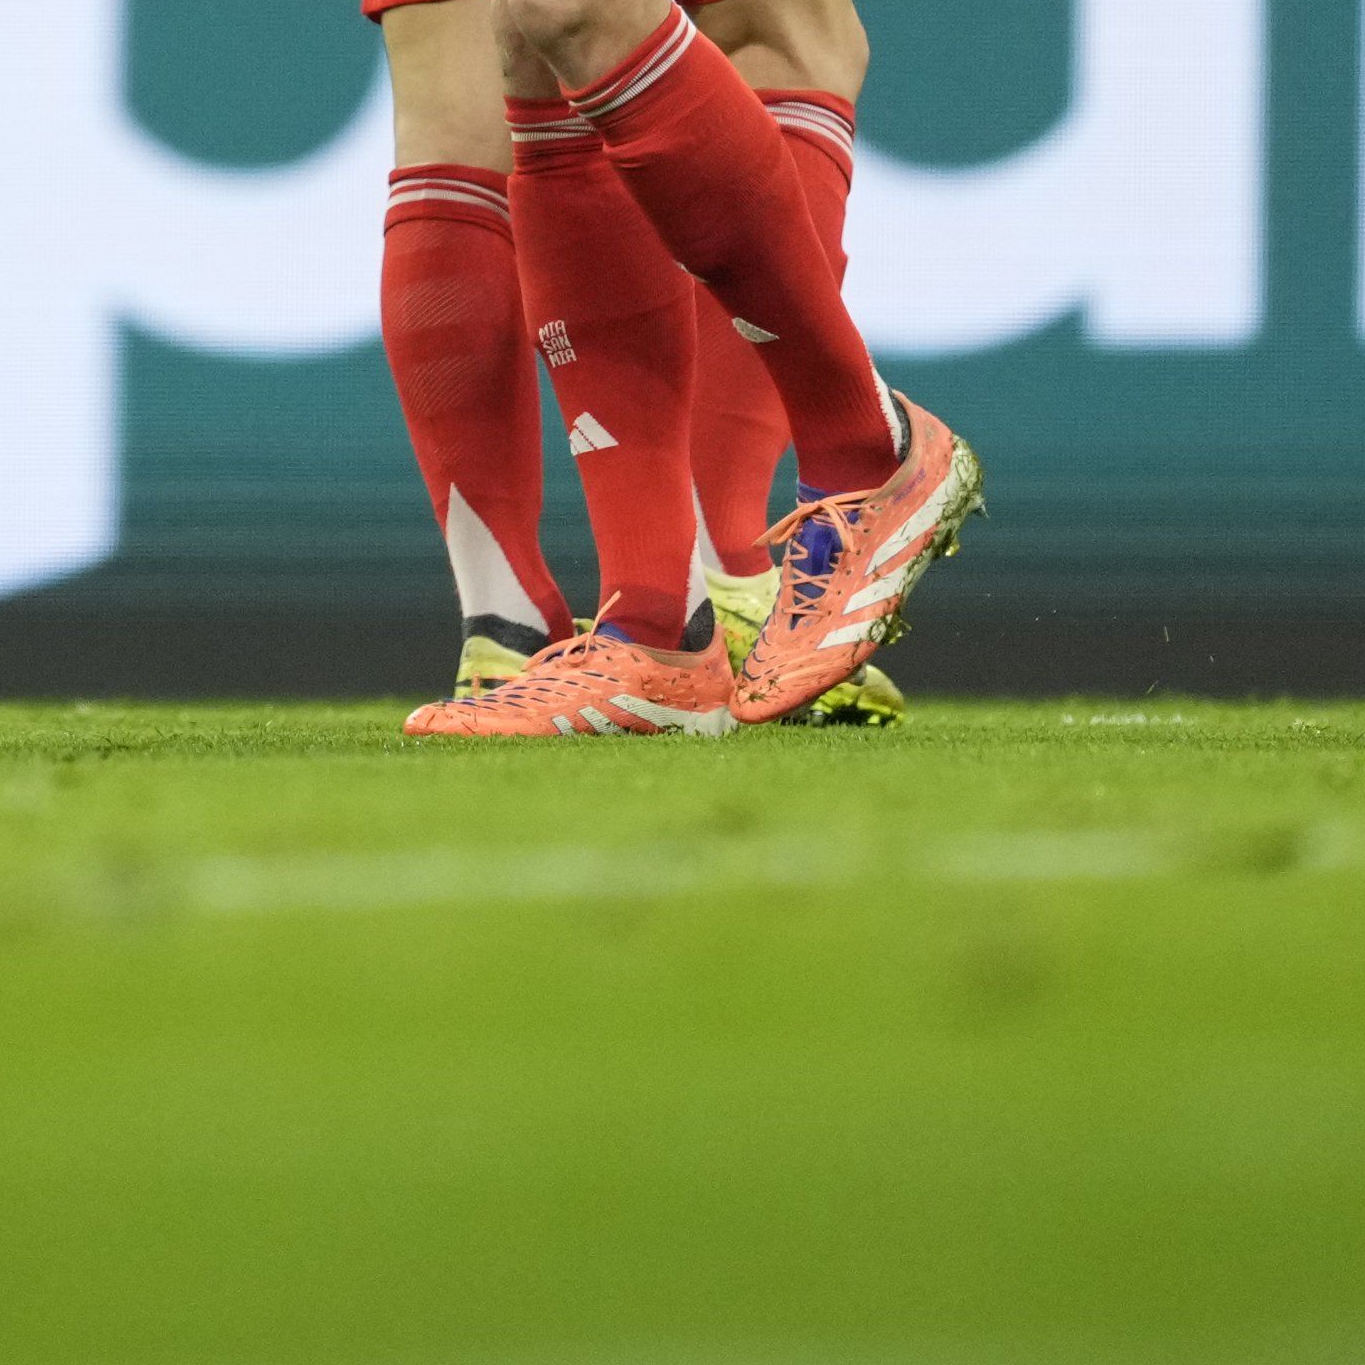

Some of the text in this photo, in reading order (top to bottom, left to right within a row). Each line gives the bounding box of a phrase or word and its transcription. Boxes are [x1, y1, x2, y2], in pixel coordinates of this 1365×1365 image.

[538, 319, 566, 343] MIA
[542, 334, 571, 354] SAN
[548, 348, 577, 368] MIA
